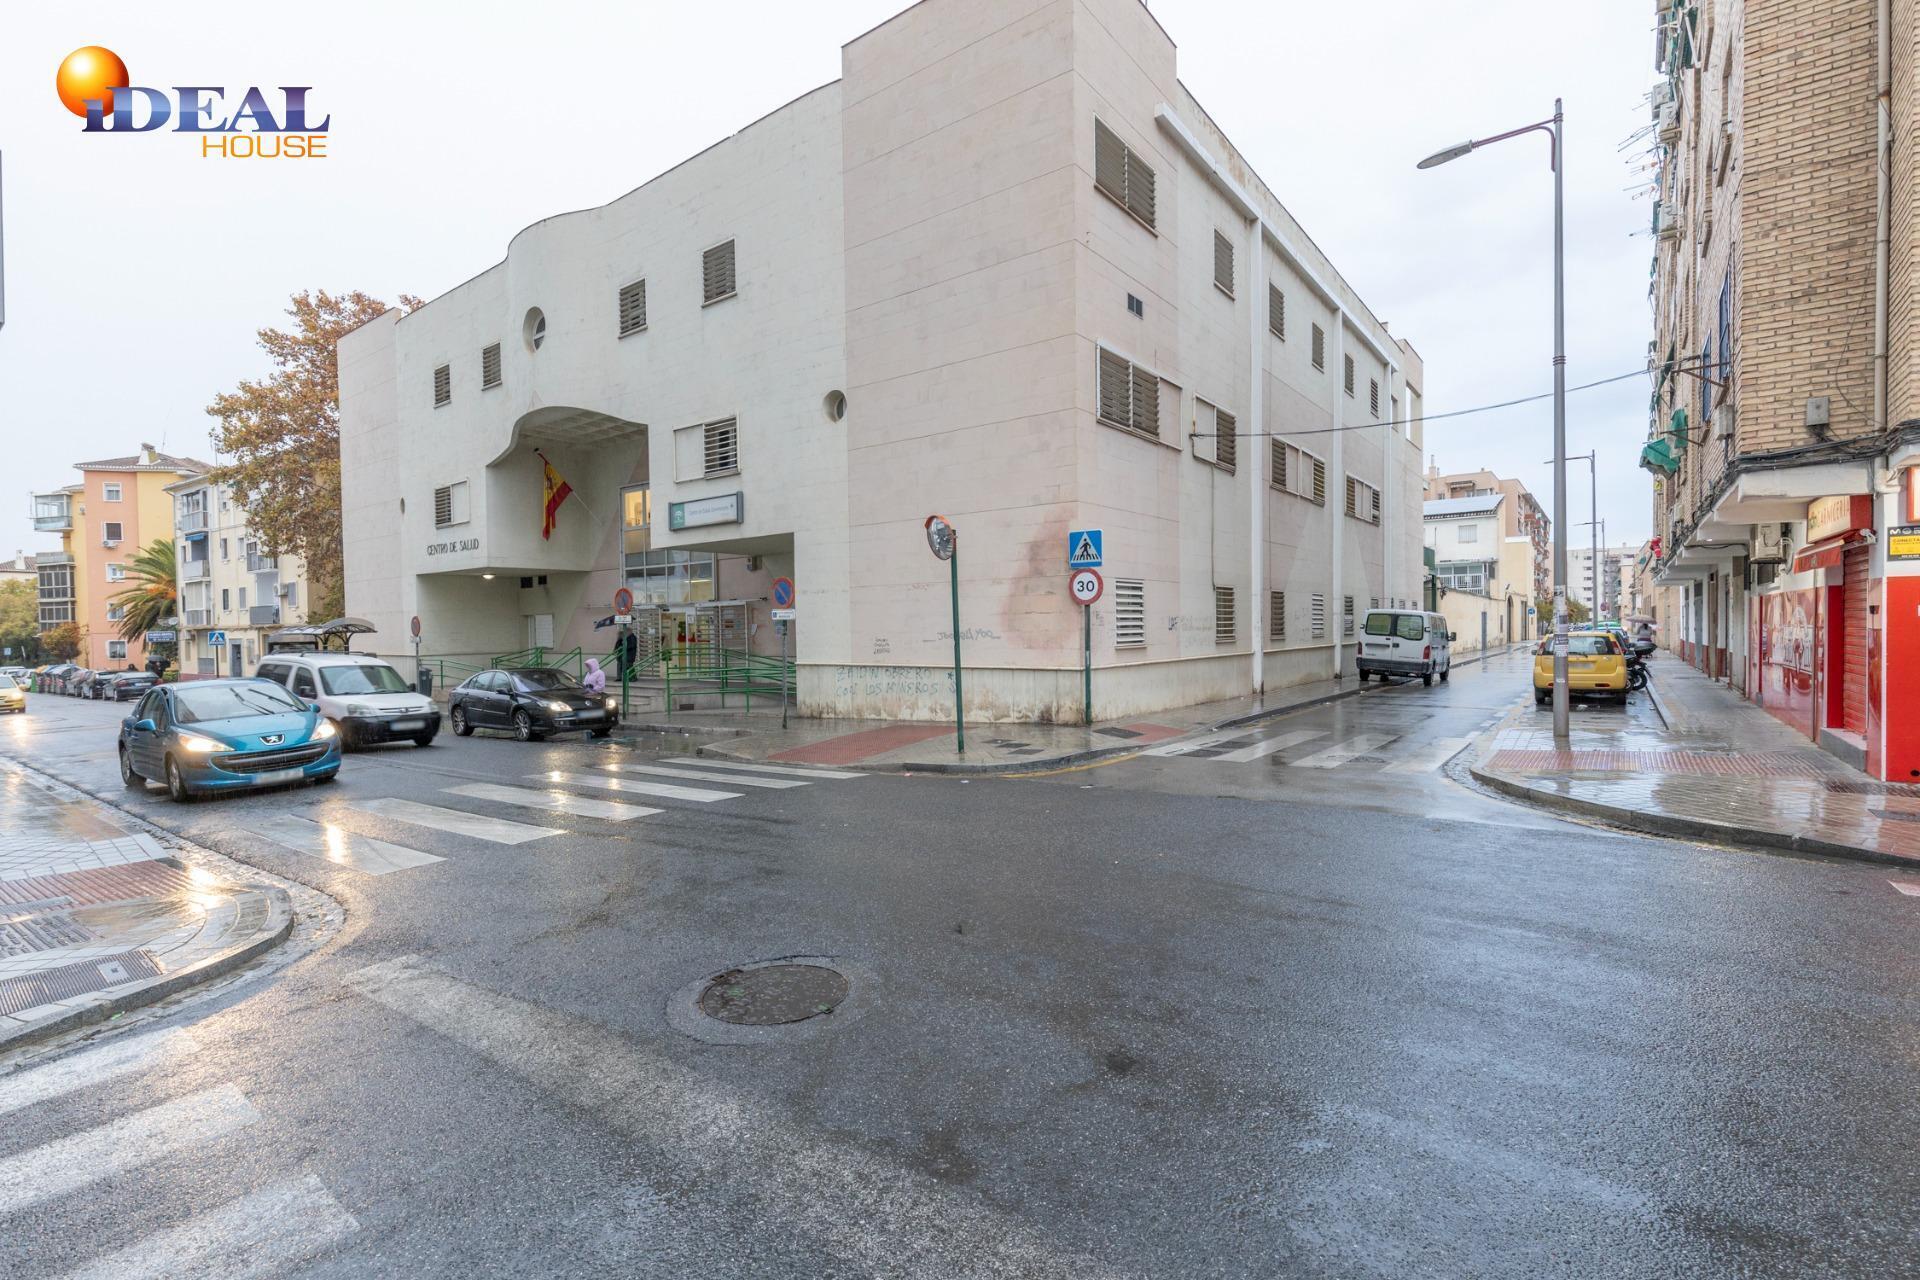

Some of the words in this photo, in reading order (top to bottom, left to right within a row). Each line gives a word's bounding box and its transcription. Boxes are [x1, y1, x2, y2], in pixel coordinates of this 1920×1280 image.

[426, 543, 448, 556] CENTRO
[449, 541, 457, 552] DE
[459, 538, 479, 551] SALUD
[1077, 580, 1095, 592] 30
